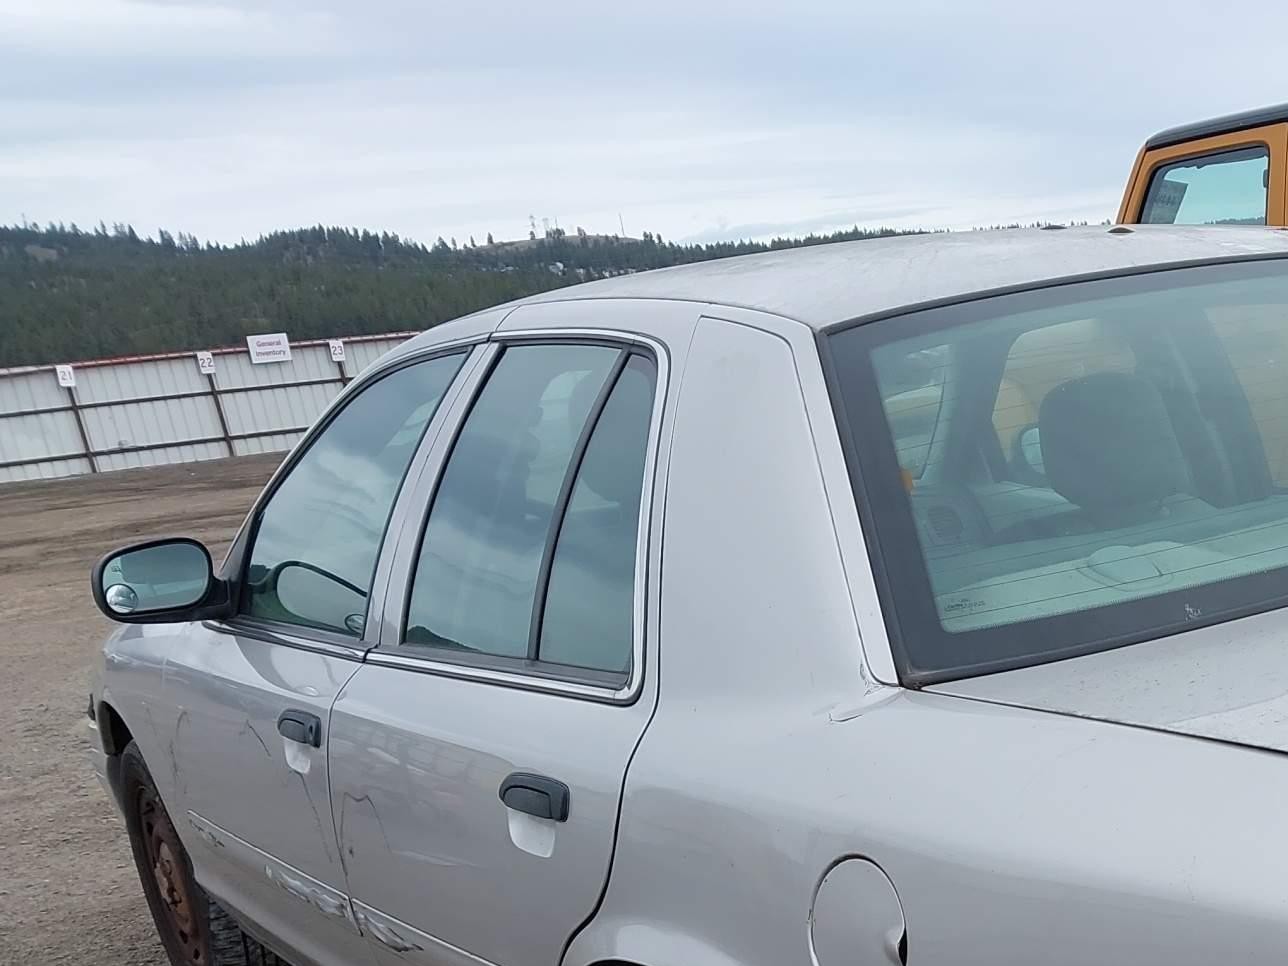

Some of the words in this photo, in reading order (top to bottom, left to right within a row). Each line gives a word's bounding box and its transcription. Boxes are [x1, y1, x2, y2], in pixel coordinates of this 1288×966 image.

[256, 338, 282, 347] General
[255, 349, 286, 357] Inventory
[331, 345, 344, 356] 23
[199, 357, 214, 368] 22
[59, 370, 73, 381] 21
